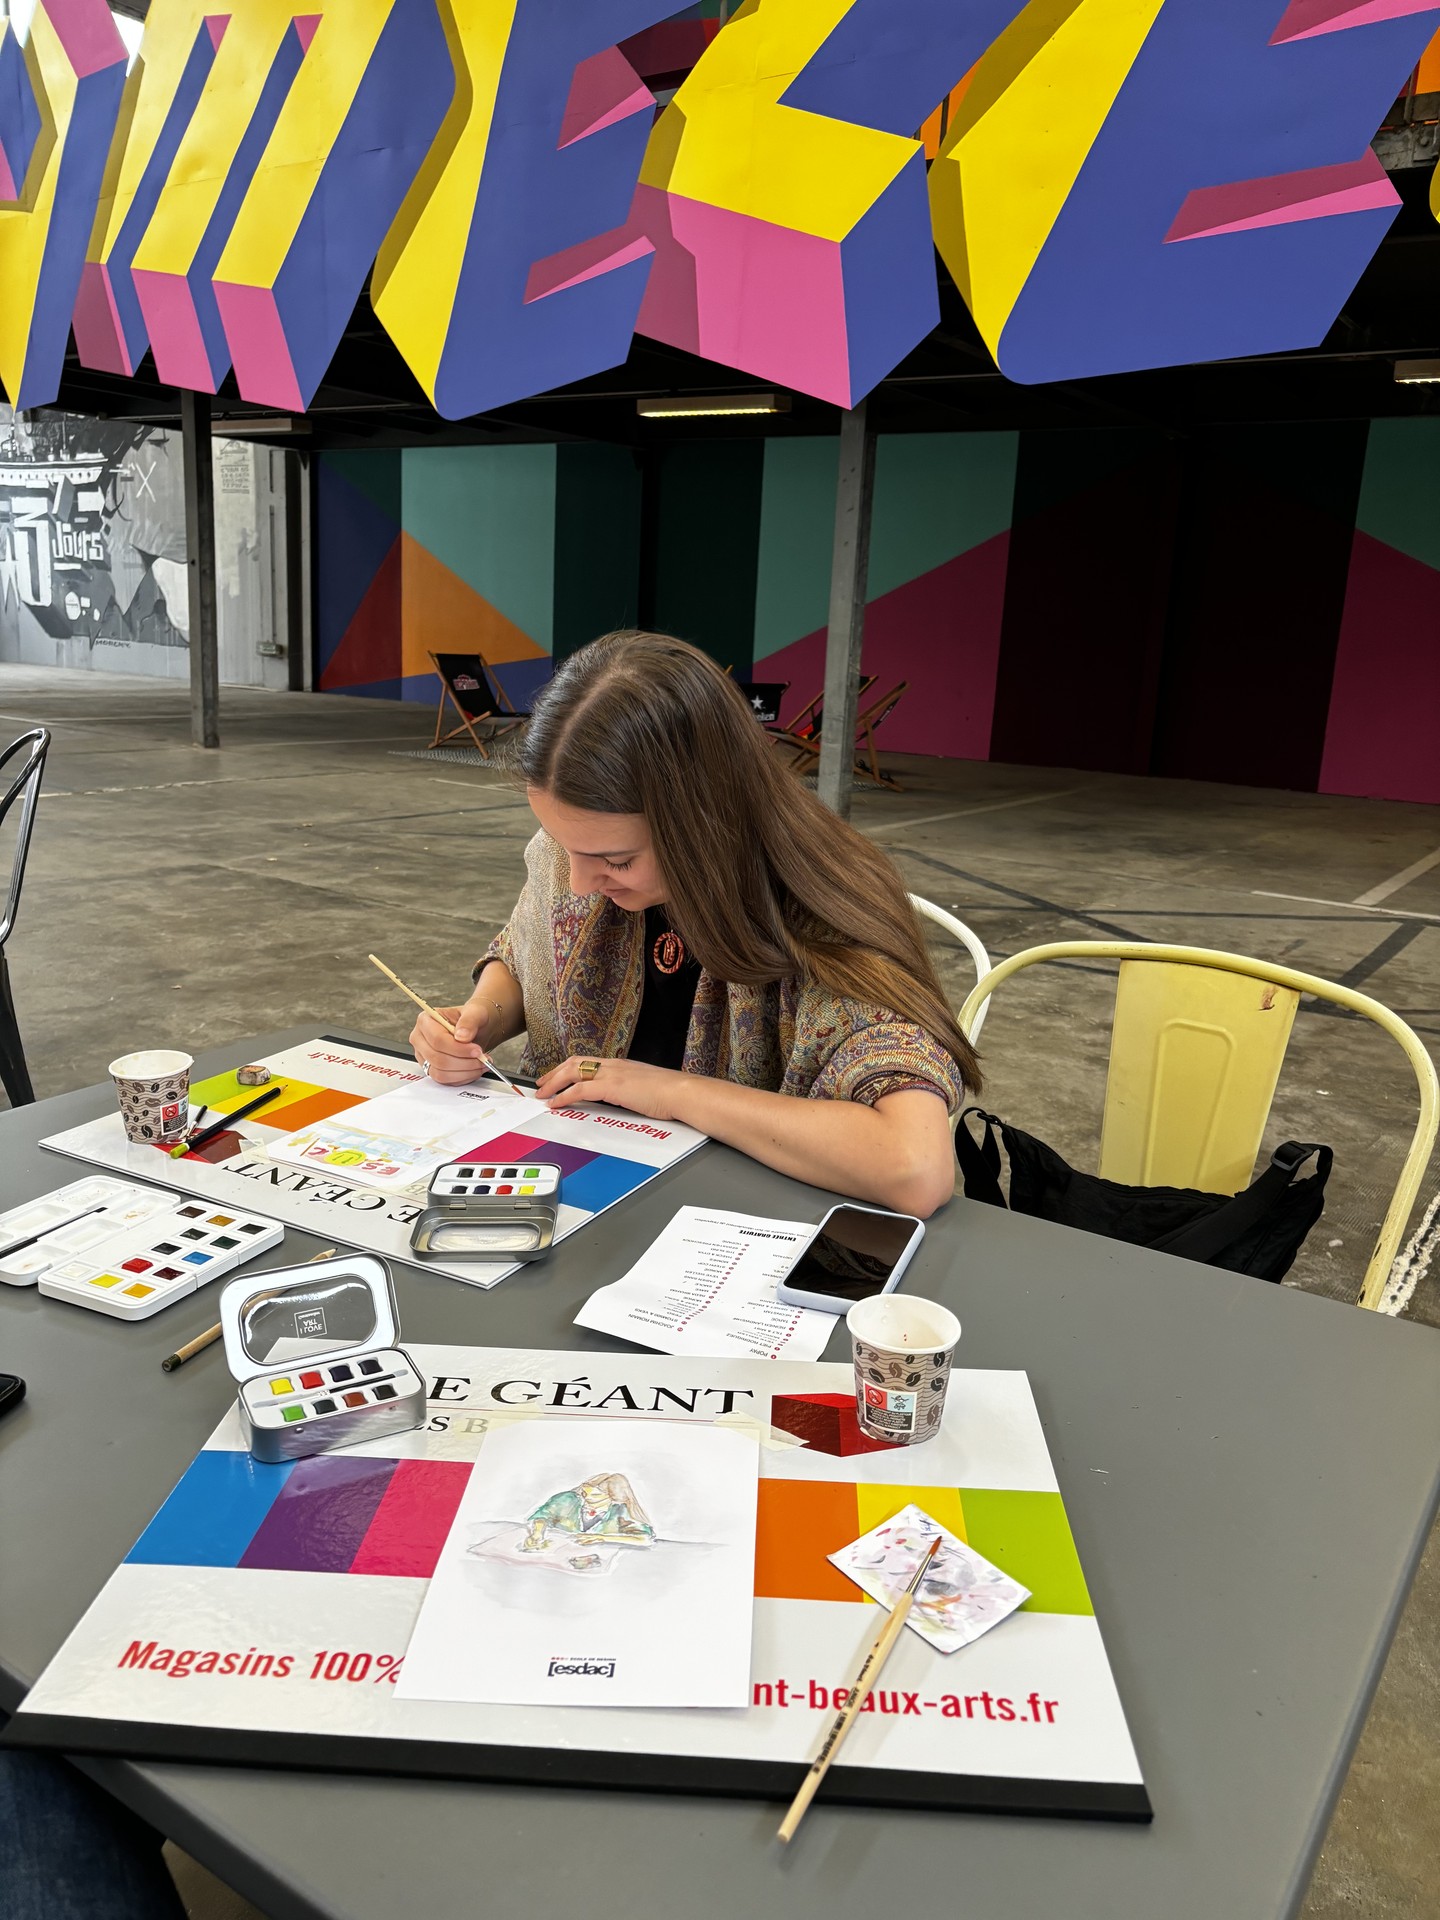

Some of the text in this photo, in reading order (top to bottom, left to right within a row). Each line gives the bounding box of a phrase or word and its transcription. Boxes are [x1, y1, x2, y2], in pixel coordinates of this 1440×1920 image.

[308, 1052, 424, 1081] nt-beaux-arts.fr
[594, 1117, 672, 1140] Magasins
[738, 1229, 797, 1243] ENTRÉE GRATUITE
[749, 1348, 769, 1357] POPAY
[490, 1376, 755, 1415] GÉANT
[117, 1640, 405, 1683] Magasins 100%
